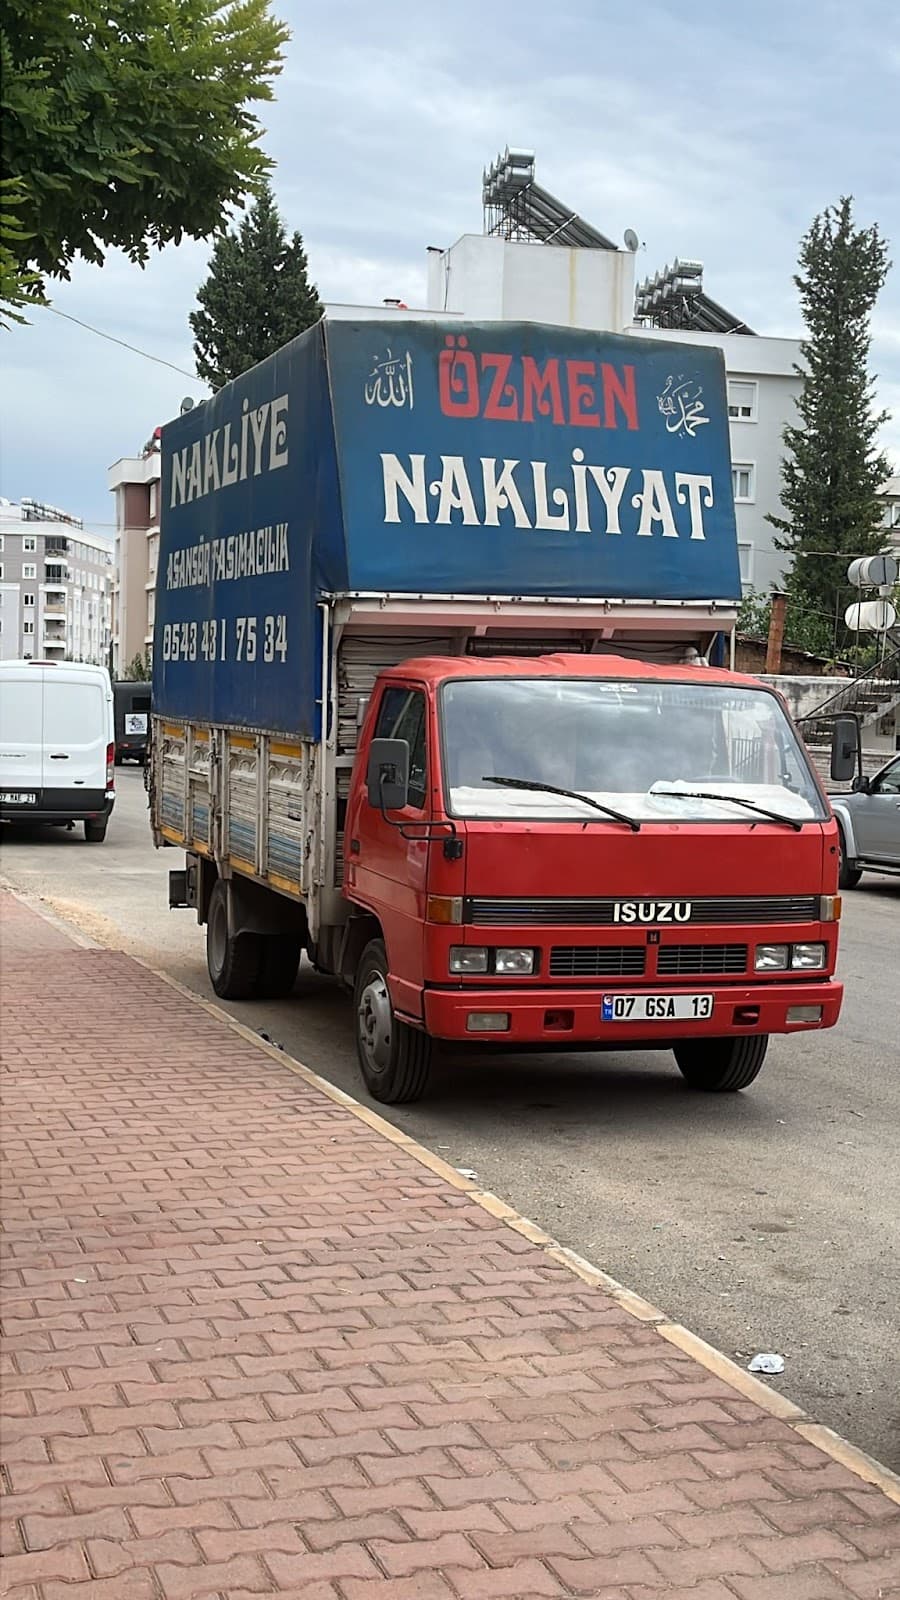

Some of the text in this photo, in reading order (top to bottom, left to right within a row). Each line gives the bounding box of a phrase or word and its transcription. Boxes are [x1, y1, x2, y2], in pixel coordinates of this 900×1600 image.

[438, 335, 640, 431] ÖZMEN
[170, 393, 289, 509] NAKLİYE
[379, 447, 714, 540] NAKLİYAT
[163, 622, 197, 662] 0543
[236, 617, 257, 662] 75
[263, 614, 287, 663] 34
[613, 903, 692, 922] ISUZU
[614, 998, 635, 1017] 07
[646, 998, 675, 1017] GSA
[692, 997, 710, 1016] 13
